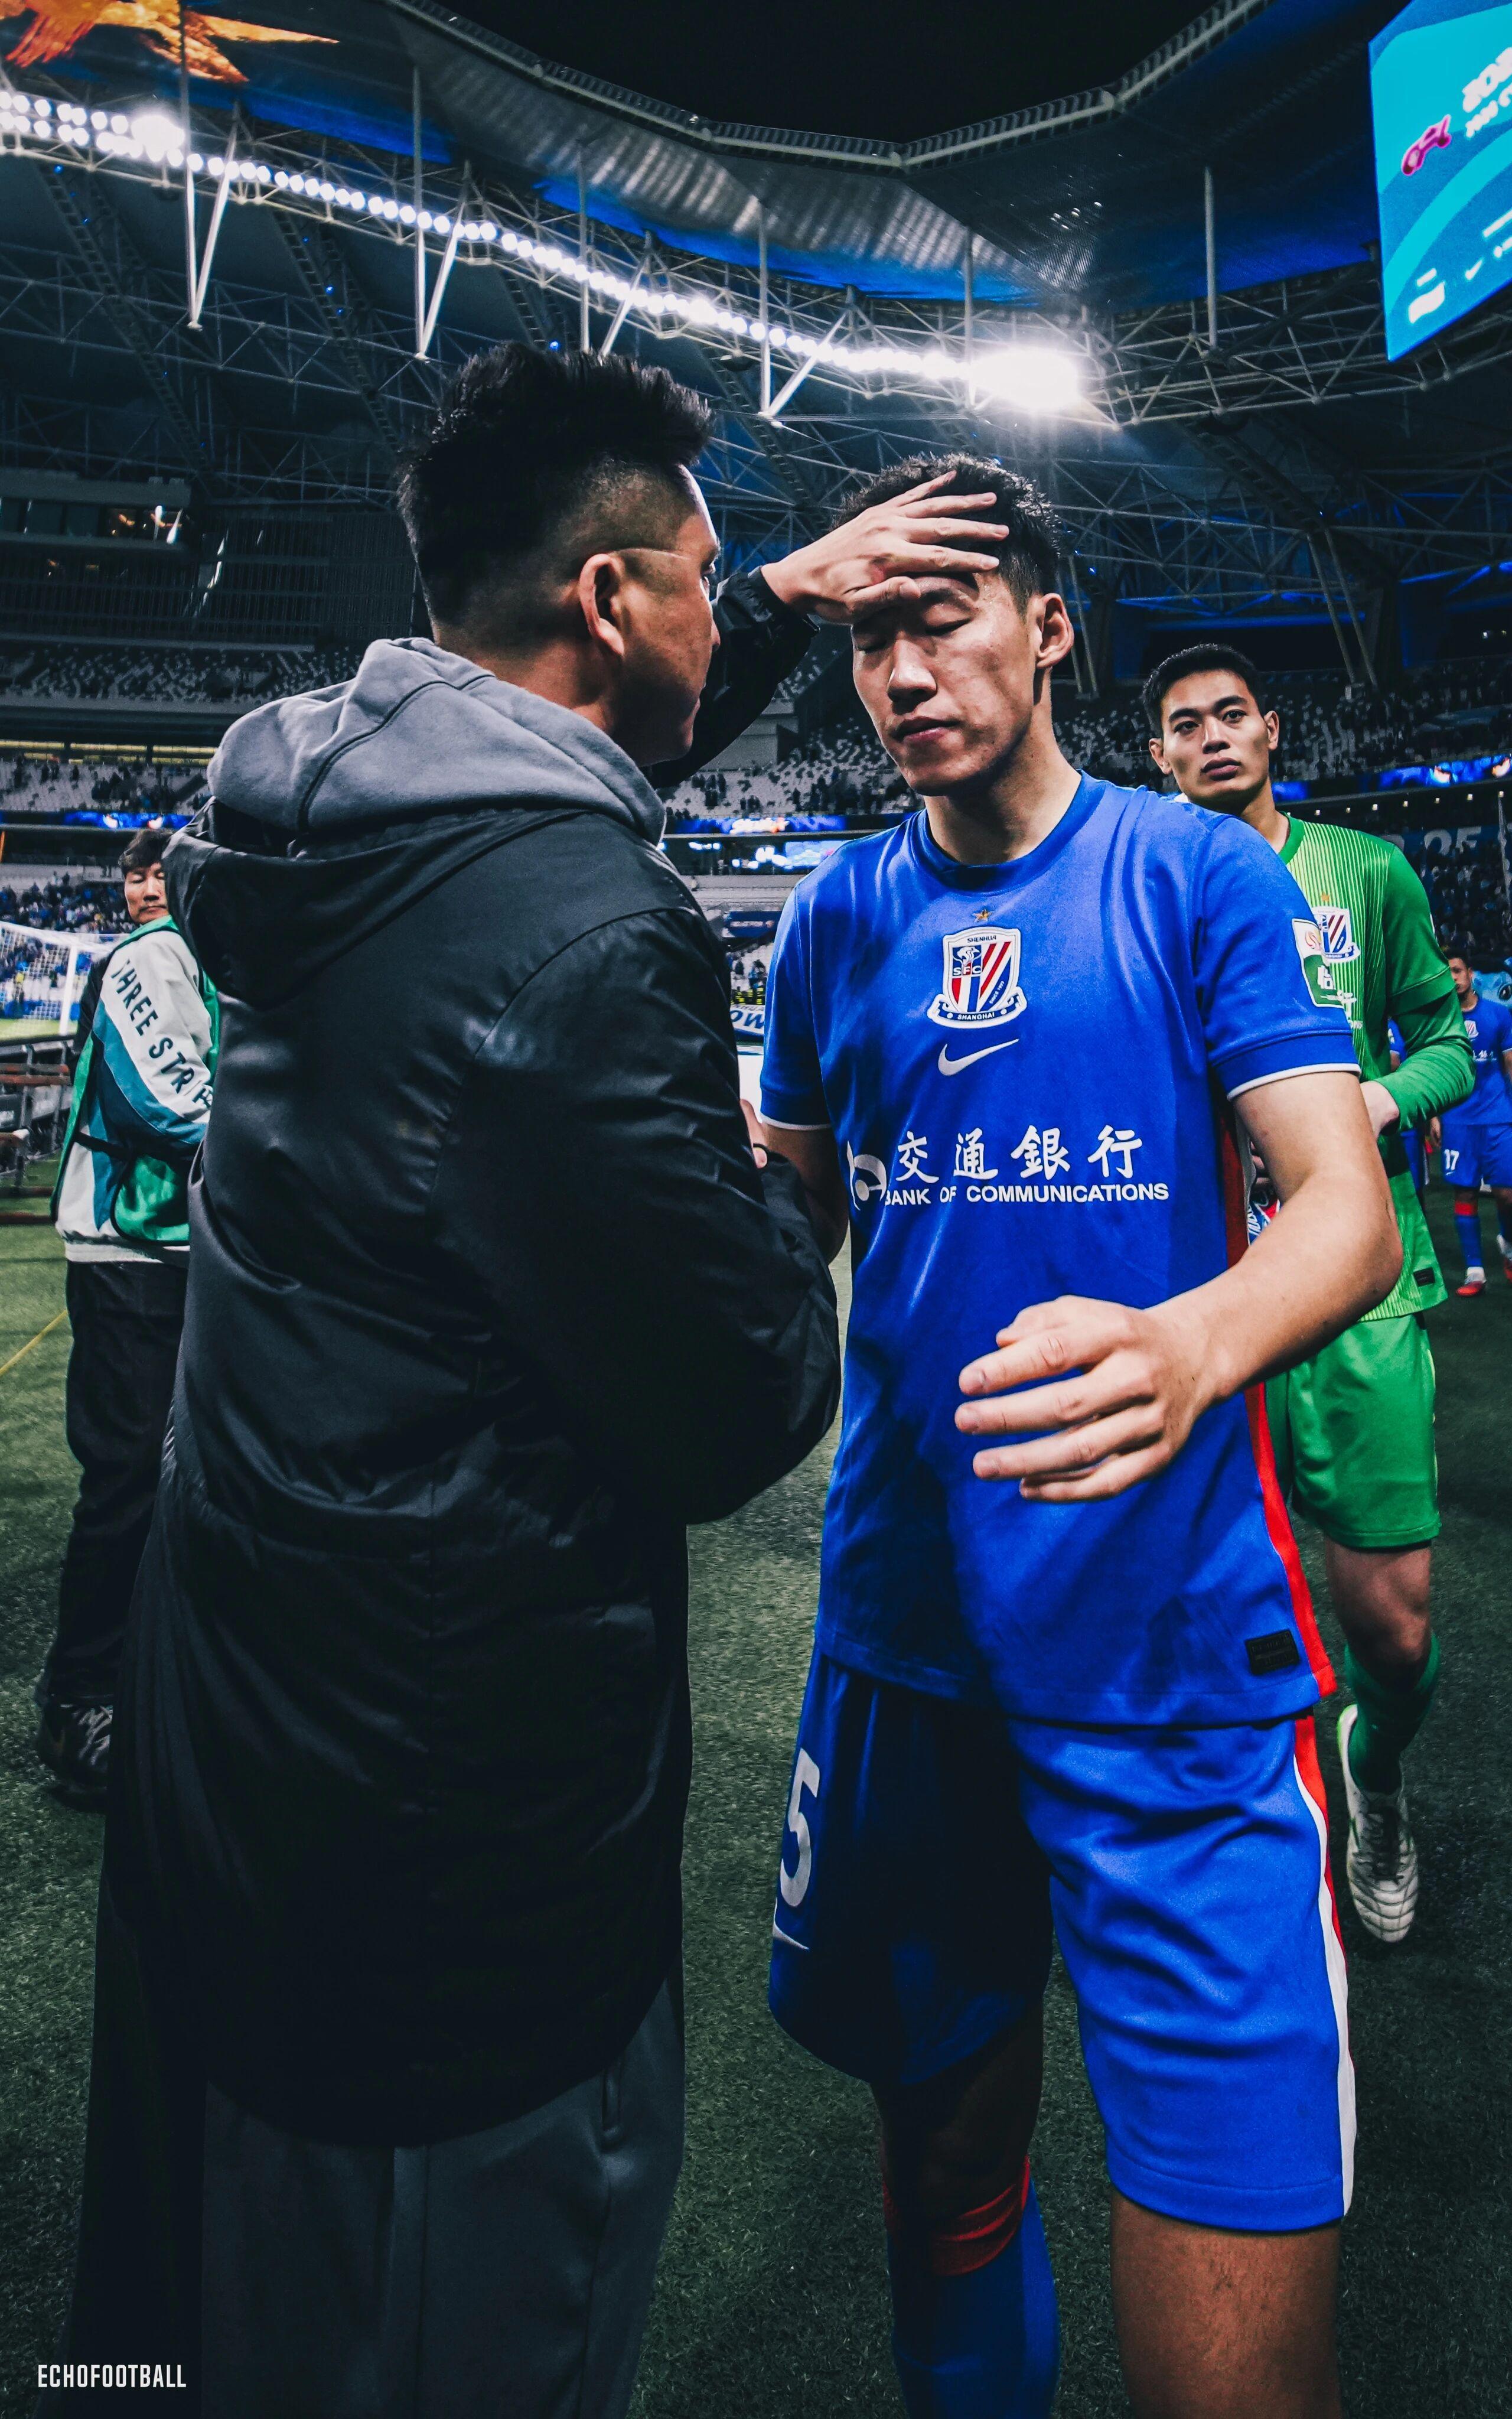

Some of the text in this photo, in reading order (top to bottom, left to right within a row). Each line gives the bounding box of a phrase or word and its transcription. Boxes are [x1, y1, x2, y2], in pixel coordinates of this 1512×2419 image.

[967, 935, 997, 943] SHENHUA
[953, 965, 982, 975] SFC
[957, 1011, 995, 1021] SHANGHAI
[895, 1125, 1142, 1182] 交通銀行
[1444, 1149, 1459, 1170] 17
[940, 1186, 957, 1203] OF
[966, 1183, 1169, 1203] COMMUNICATIONS
